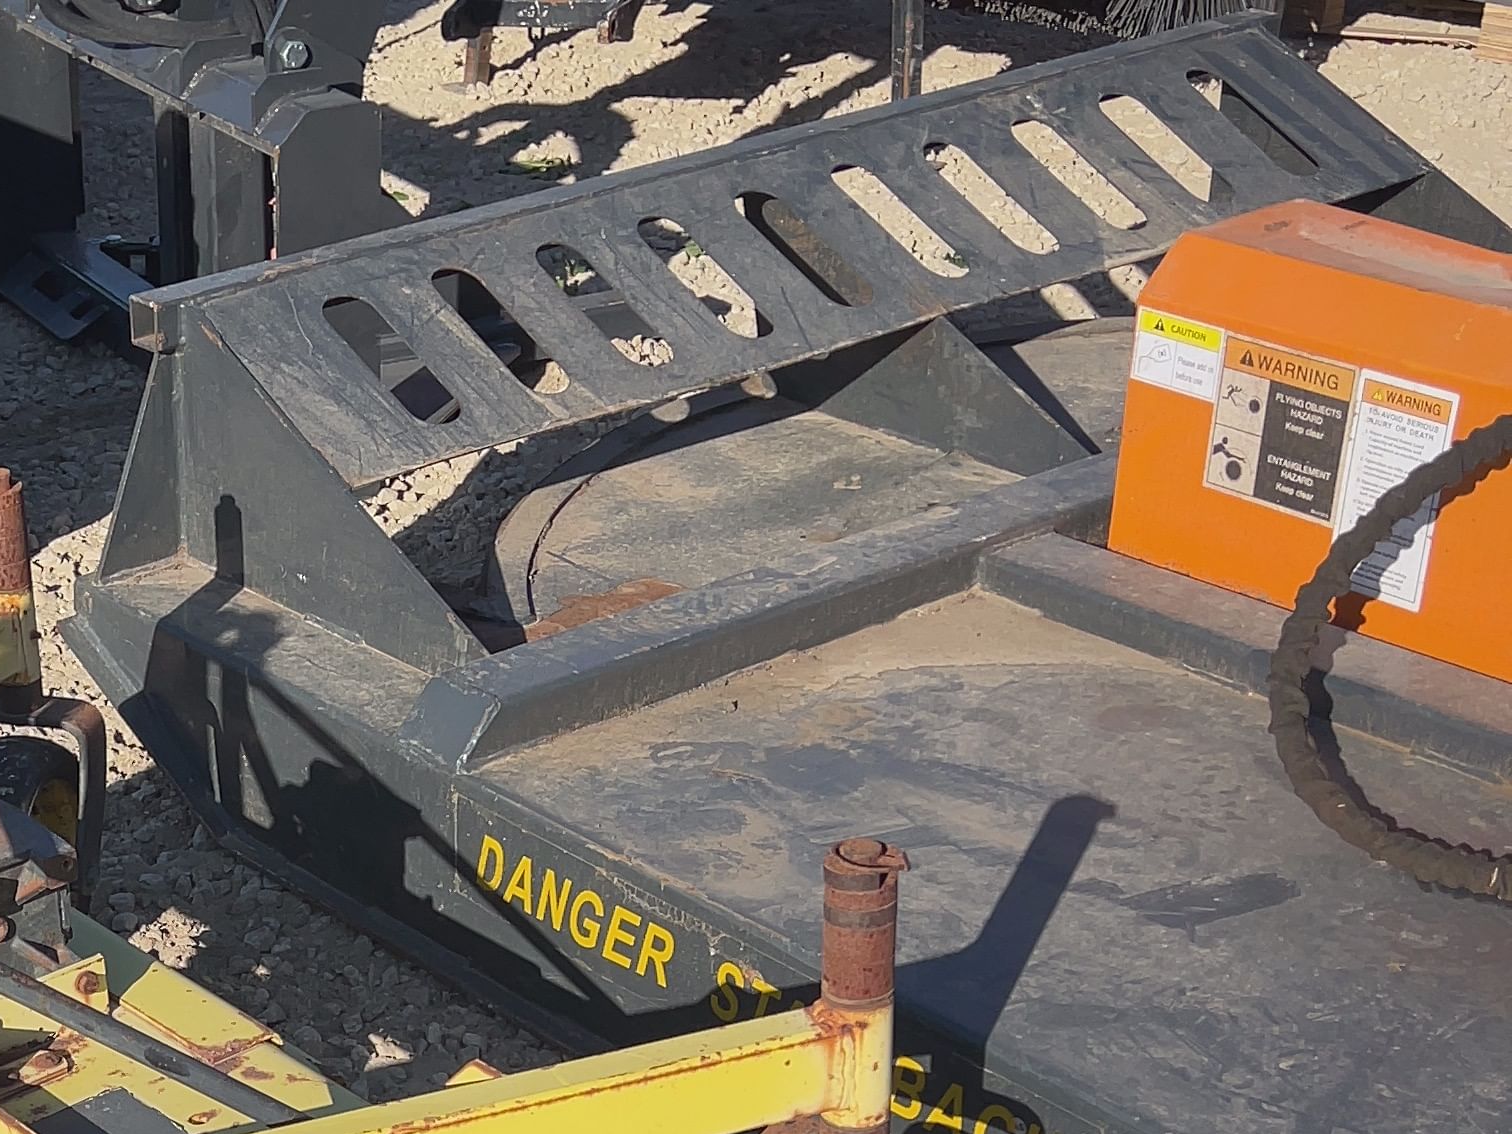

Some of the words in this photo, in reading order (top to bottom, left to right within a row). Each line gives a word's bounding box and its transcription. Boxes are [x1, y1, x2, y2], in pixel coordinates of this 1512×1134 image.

[1170, 324, 1207, 342] CAUTION
[1258, 353, 1339, 391] WARNING
[1275, 391, 1305, 409] FLYING
[1304, 401, 1343, 420] OBJECTS
[1385, 390, 1442, 417] WARNING
[1290, 408, 1324, 425] HAZARD
[1379, 410, 1404, 423] AVOID
[1406, 417, 1440, 434] SERIOUS
[1284, 421, 1305, 435] Keep
[1305, 427, 1325, 440] clear
[1367, 417, 1392, 431] INJURY
[1395, 424, 1407, 434] OR
[1409, 429, 1435, 441] DEATH
[1266, 453, 1332, 481] ENTANGLEMENT
[1280, 468, 1314, 487] HAZARD
[1274, 481, 1295, 496] Keep
[1295, 489, 1314, 502] clear
[476, 834, 676, 989] DANGER
[710, 961, 806, 1022] ST
